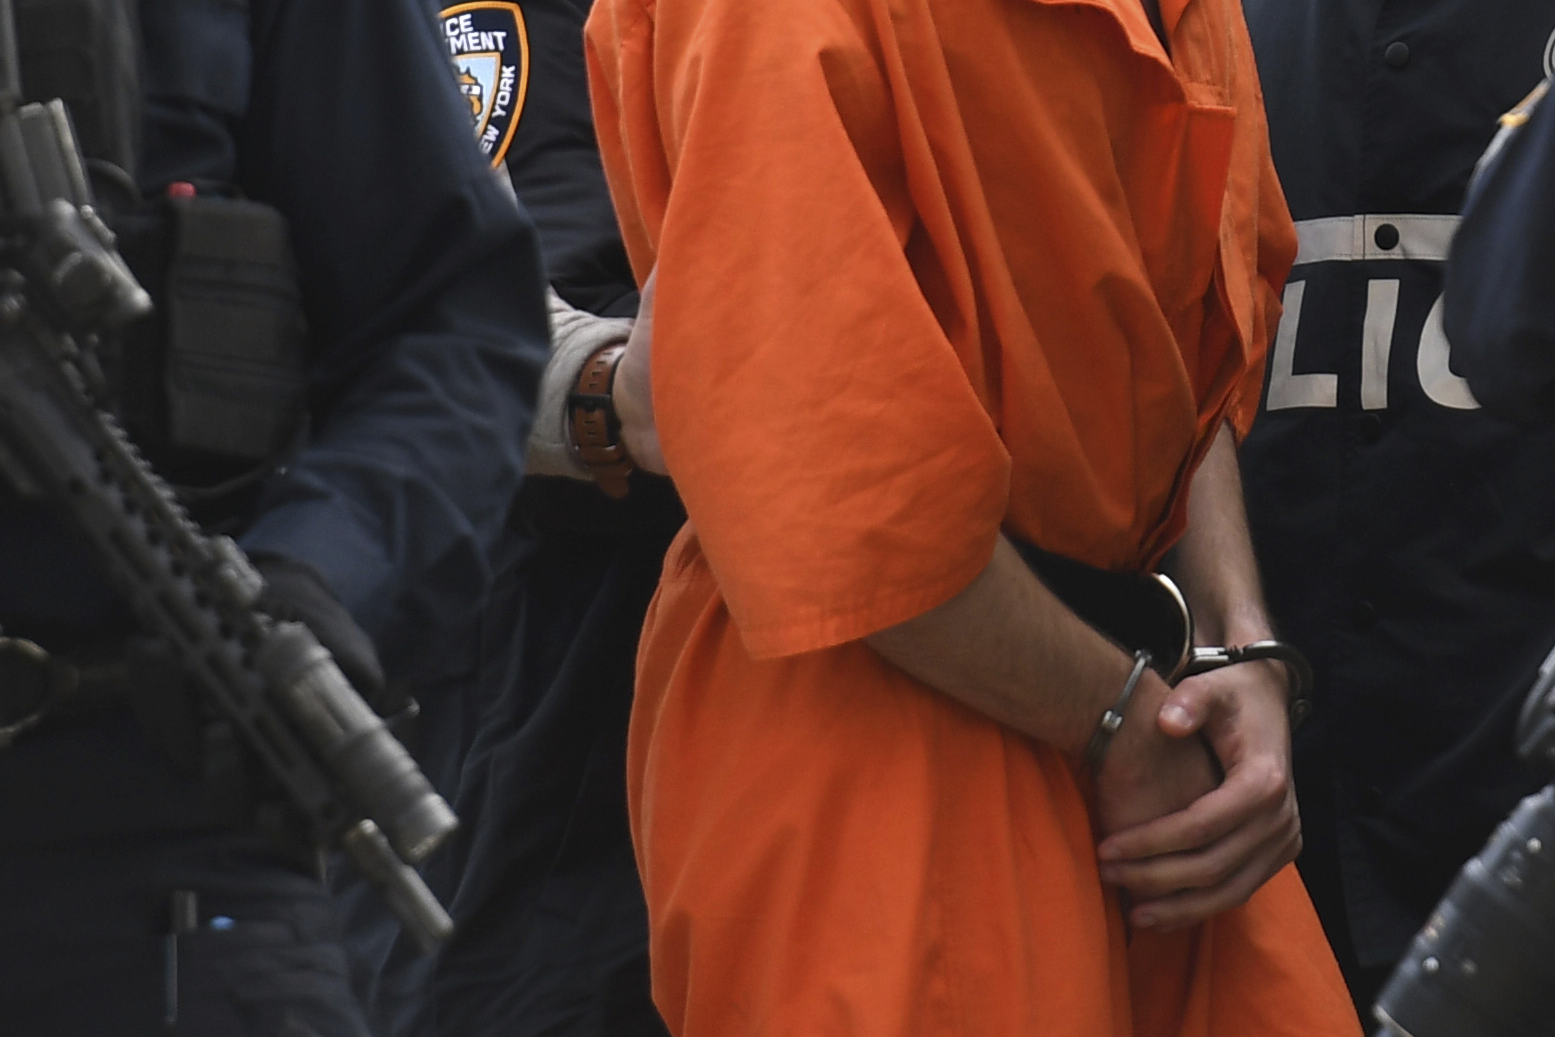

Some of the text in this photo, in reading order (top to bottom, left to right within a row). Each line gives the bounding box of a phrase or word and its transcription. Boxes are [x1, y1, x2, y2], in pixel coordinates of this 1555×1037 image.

[440, 13, 474, 36] CE
[445, 31, 507, 55] MENT
[491, 65, 516, 117] YORK
